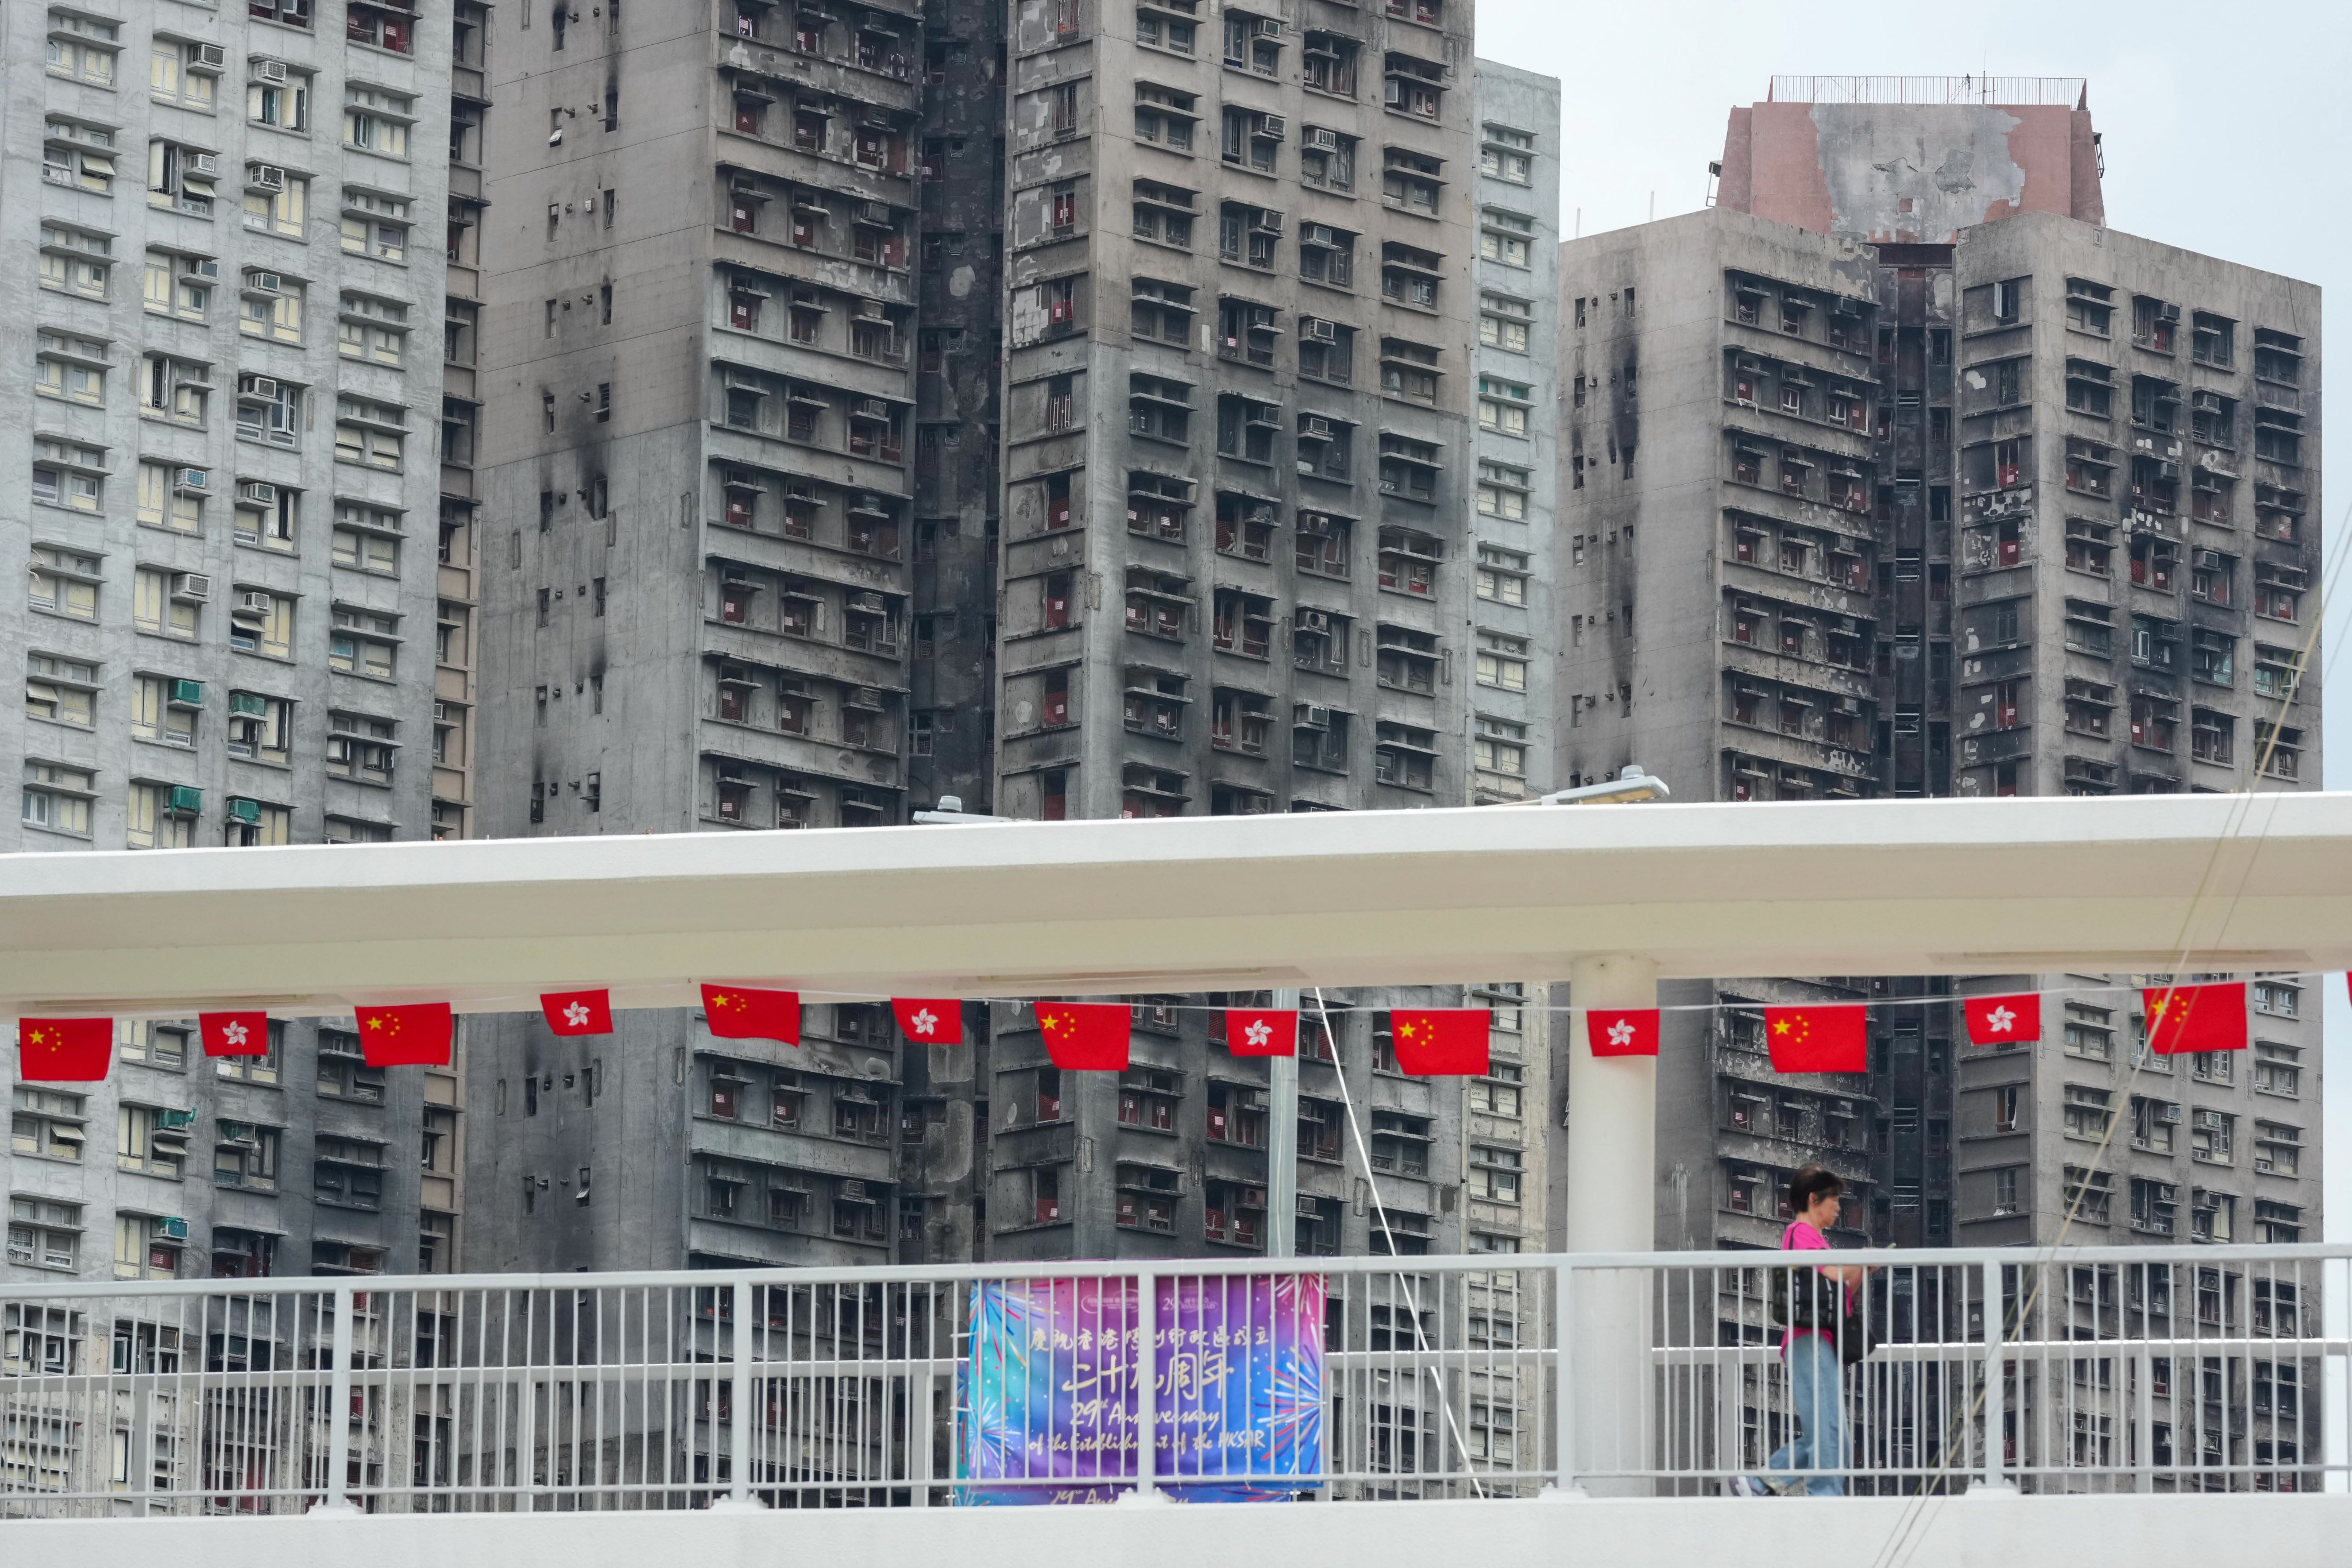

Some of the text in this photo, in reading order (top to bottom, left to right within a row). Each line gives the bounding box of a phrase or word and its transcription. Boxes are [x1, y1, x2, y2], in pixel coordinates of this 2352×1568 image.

[1029, 1433, 1044, 1456] of
[1048, 1433, 1068, 1451] the
[1192, 1432, 1213, 1450] the
